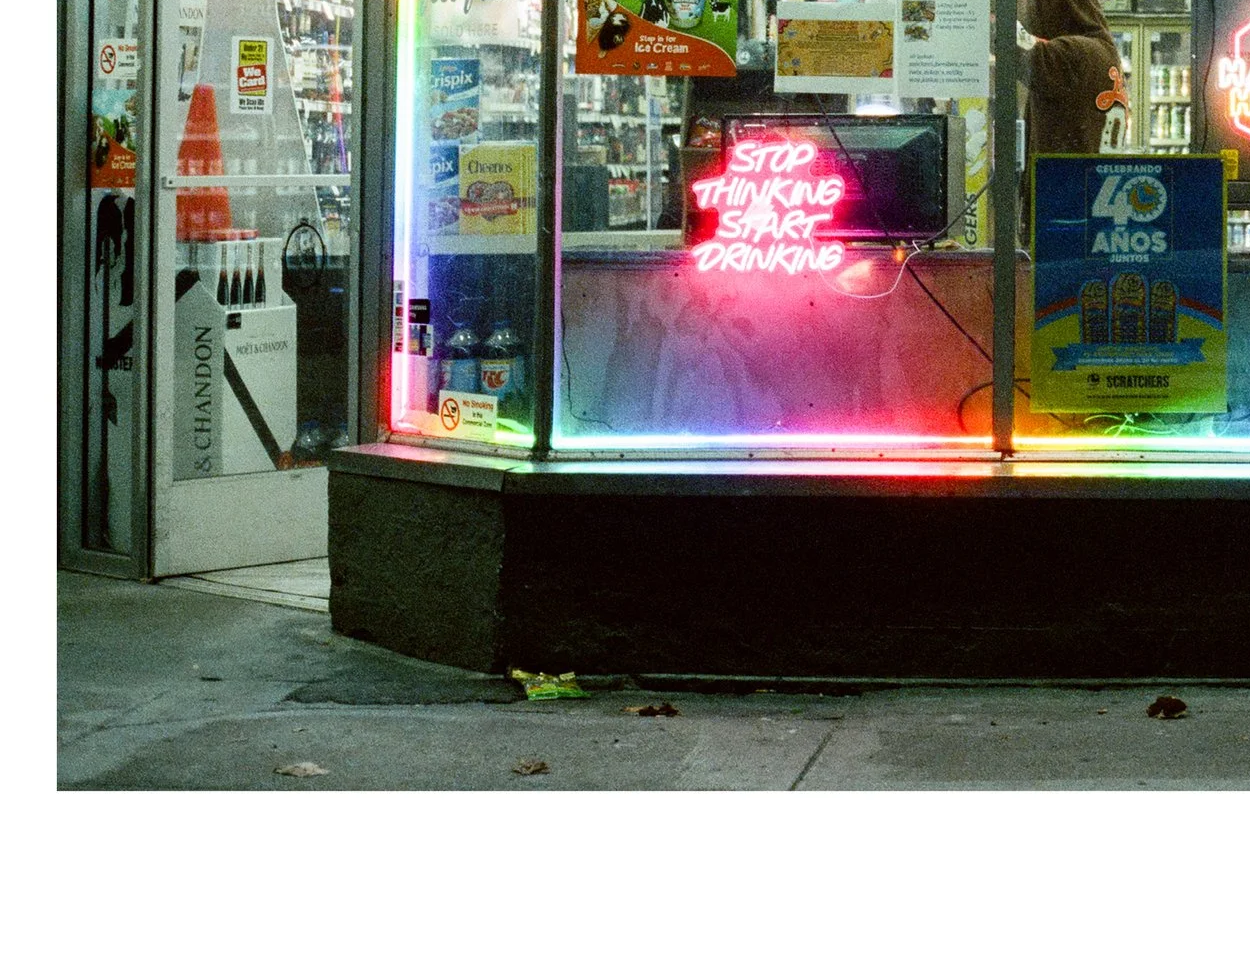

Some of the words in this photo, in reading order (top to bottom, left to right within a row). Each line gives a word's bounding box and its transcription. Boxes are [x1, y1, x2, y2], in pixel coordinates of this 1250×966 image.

[634, 42, 651, 53] Ice
[653, 42, 689, 54] Cream
[243, 67, 262, 77] We
[238, 75, 266, 88] Card
[730, 142, 815, 173] STOP
[468, 160, 513, 174] Cheerios
[1095, 164, 1162, 173] CELEBRANDO
[693, 177, 843, 209] THINKING
[1091, 175, 1168, 225] 40
[718, 210, 831, 243] START
[1091, 226, 1167, 253] AÑOS
[692, 242, 843, 275] DRINKING
[1109, 254, 1149, 263] JUNTOS
[259, 340, 288, 354] CHANDON
[194, 325, 213, 450] CHANDON
[1106, 375, 1170, 388] SCRATCHERS
[471, 399, 494, 411] Smoking
